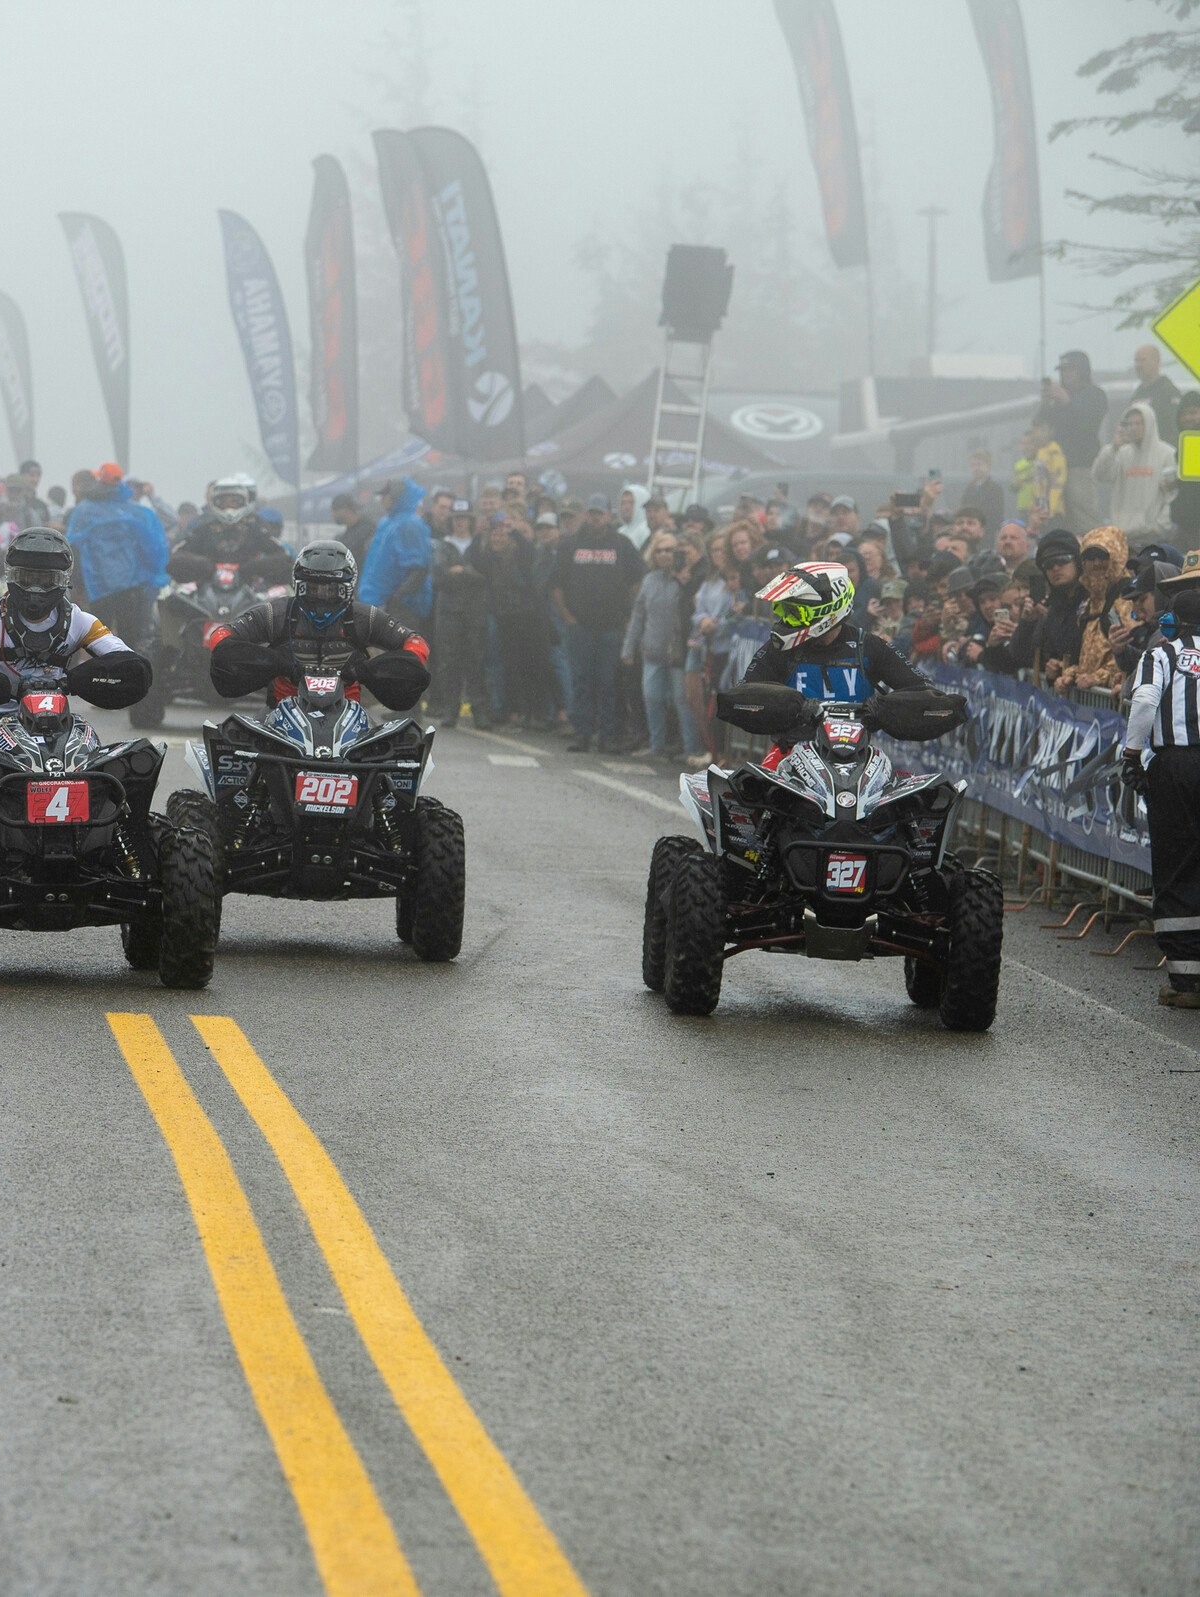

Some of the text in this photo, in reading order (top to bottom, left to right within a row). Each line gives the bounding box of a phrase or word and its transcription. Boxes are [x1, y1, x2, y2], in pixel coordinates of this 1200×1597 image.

[813, 591, 854, 617] 100%
[310, 679, 336, 689] 202
[796, 668, 858, 699] FLY
[38, 697, 54, 711] 4
[829, 724, 863, 739] 327
[219, 775, 247, 785] ACTIO
[300, 777, 353, 804] 202
[45, 786, 70, 822] 4
[305, 803, 346, 814] MICKELSON
[826, 860, 868, 887] 327
